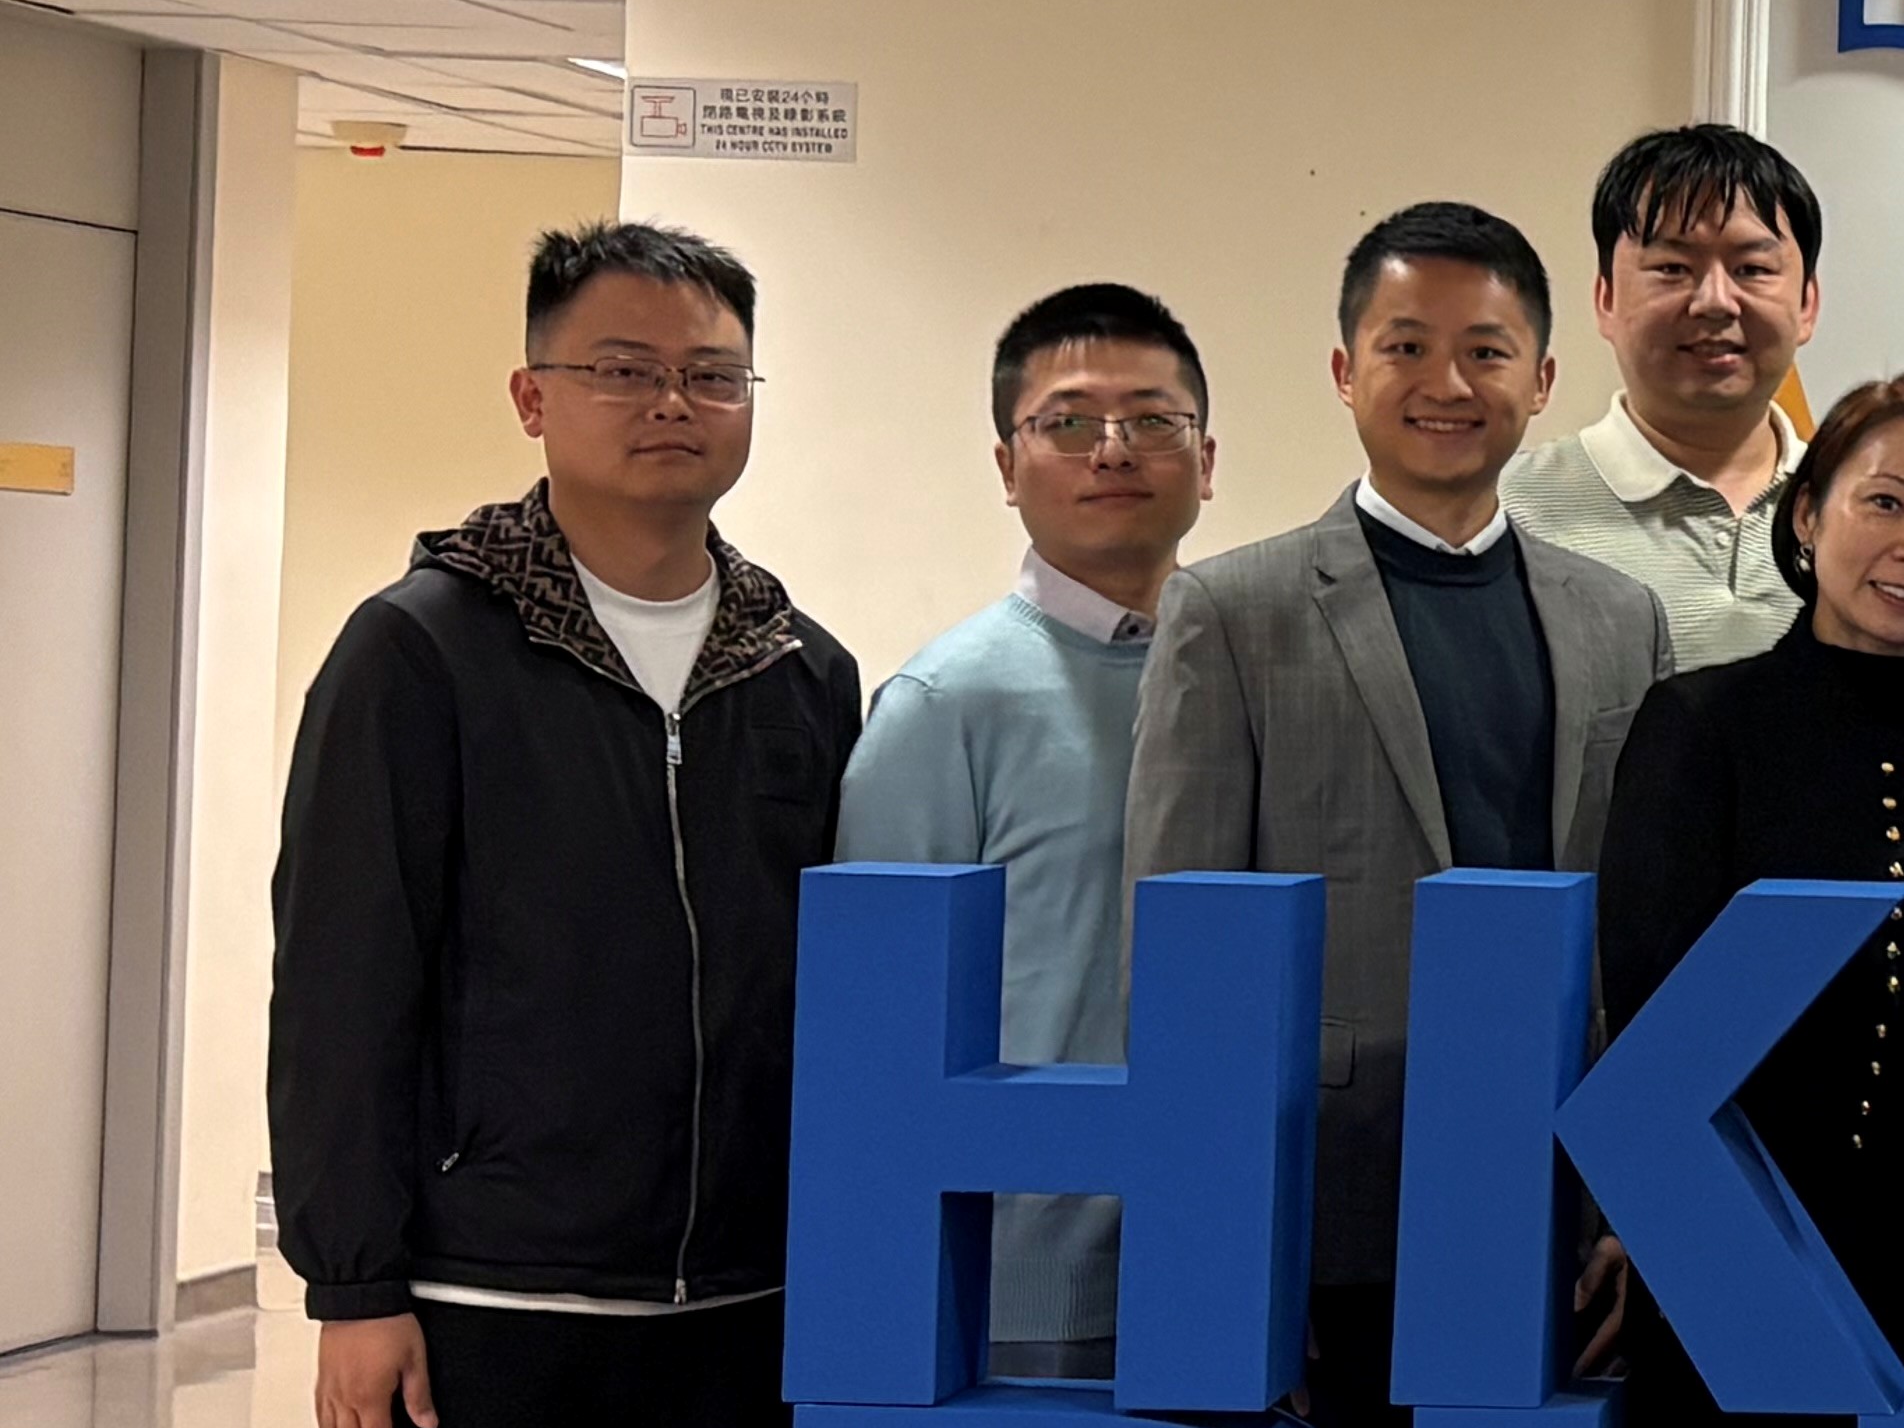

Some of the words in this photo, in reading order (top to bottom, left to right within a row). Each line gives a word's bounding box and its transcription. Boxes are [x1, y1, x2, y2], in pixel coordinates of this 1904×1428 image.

[700, 123, 723, 136] THIS
[726, 124, 764, 137] CENTRE
[769, 126, 788, 137] HAS
[791, 126, 848, 140] INSTALLED
[730, 139, 759, 152] HOUR
[762, 140, 788, 153] CCTV
[791, 141, 833, 154] SYSTEM
